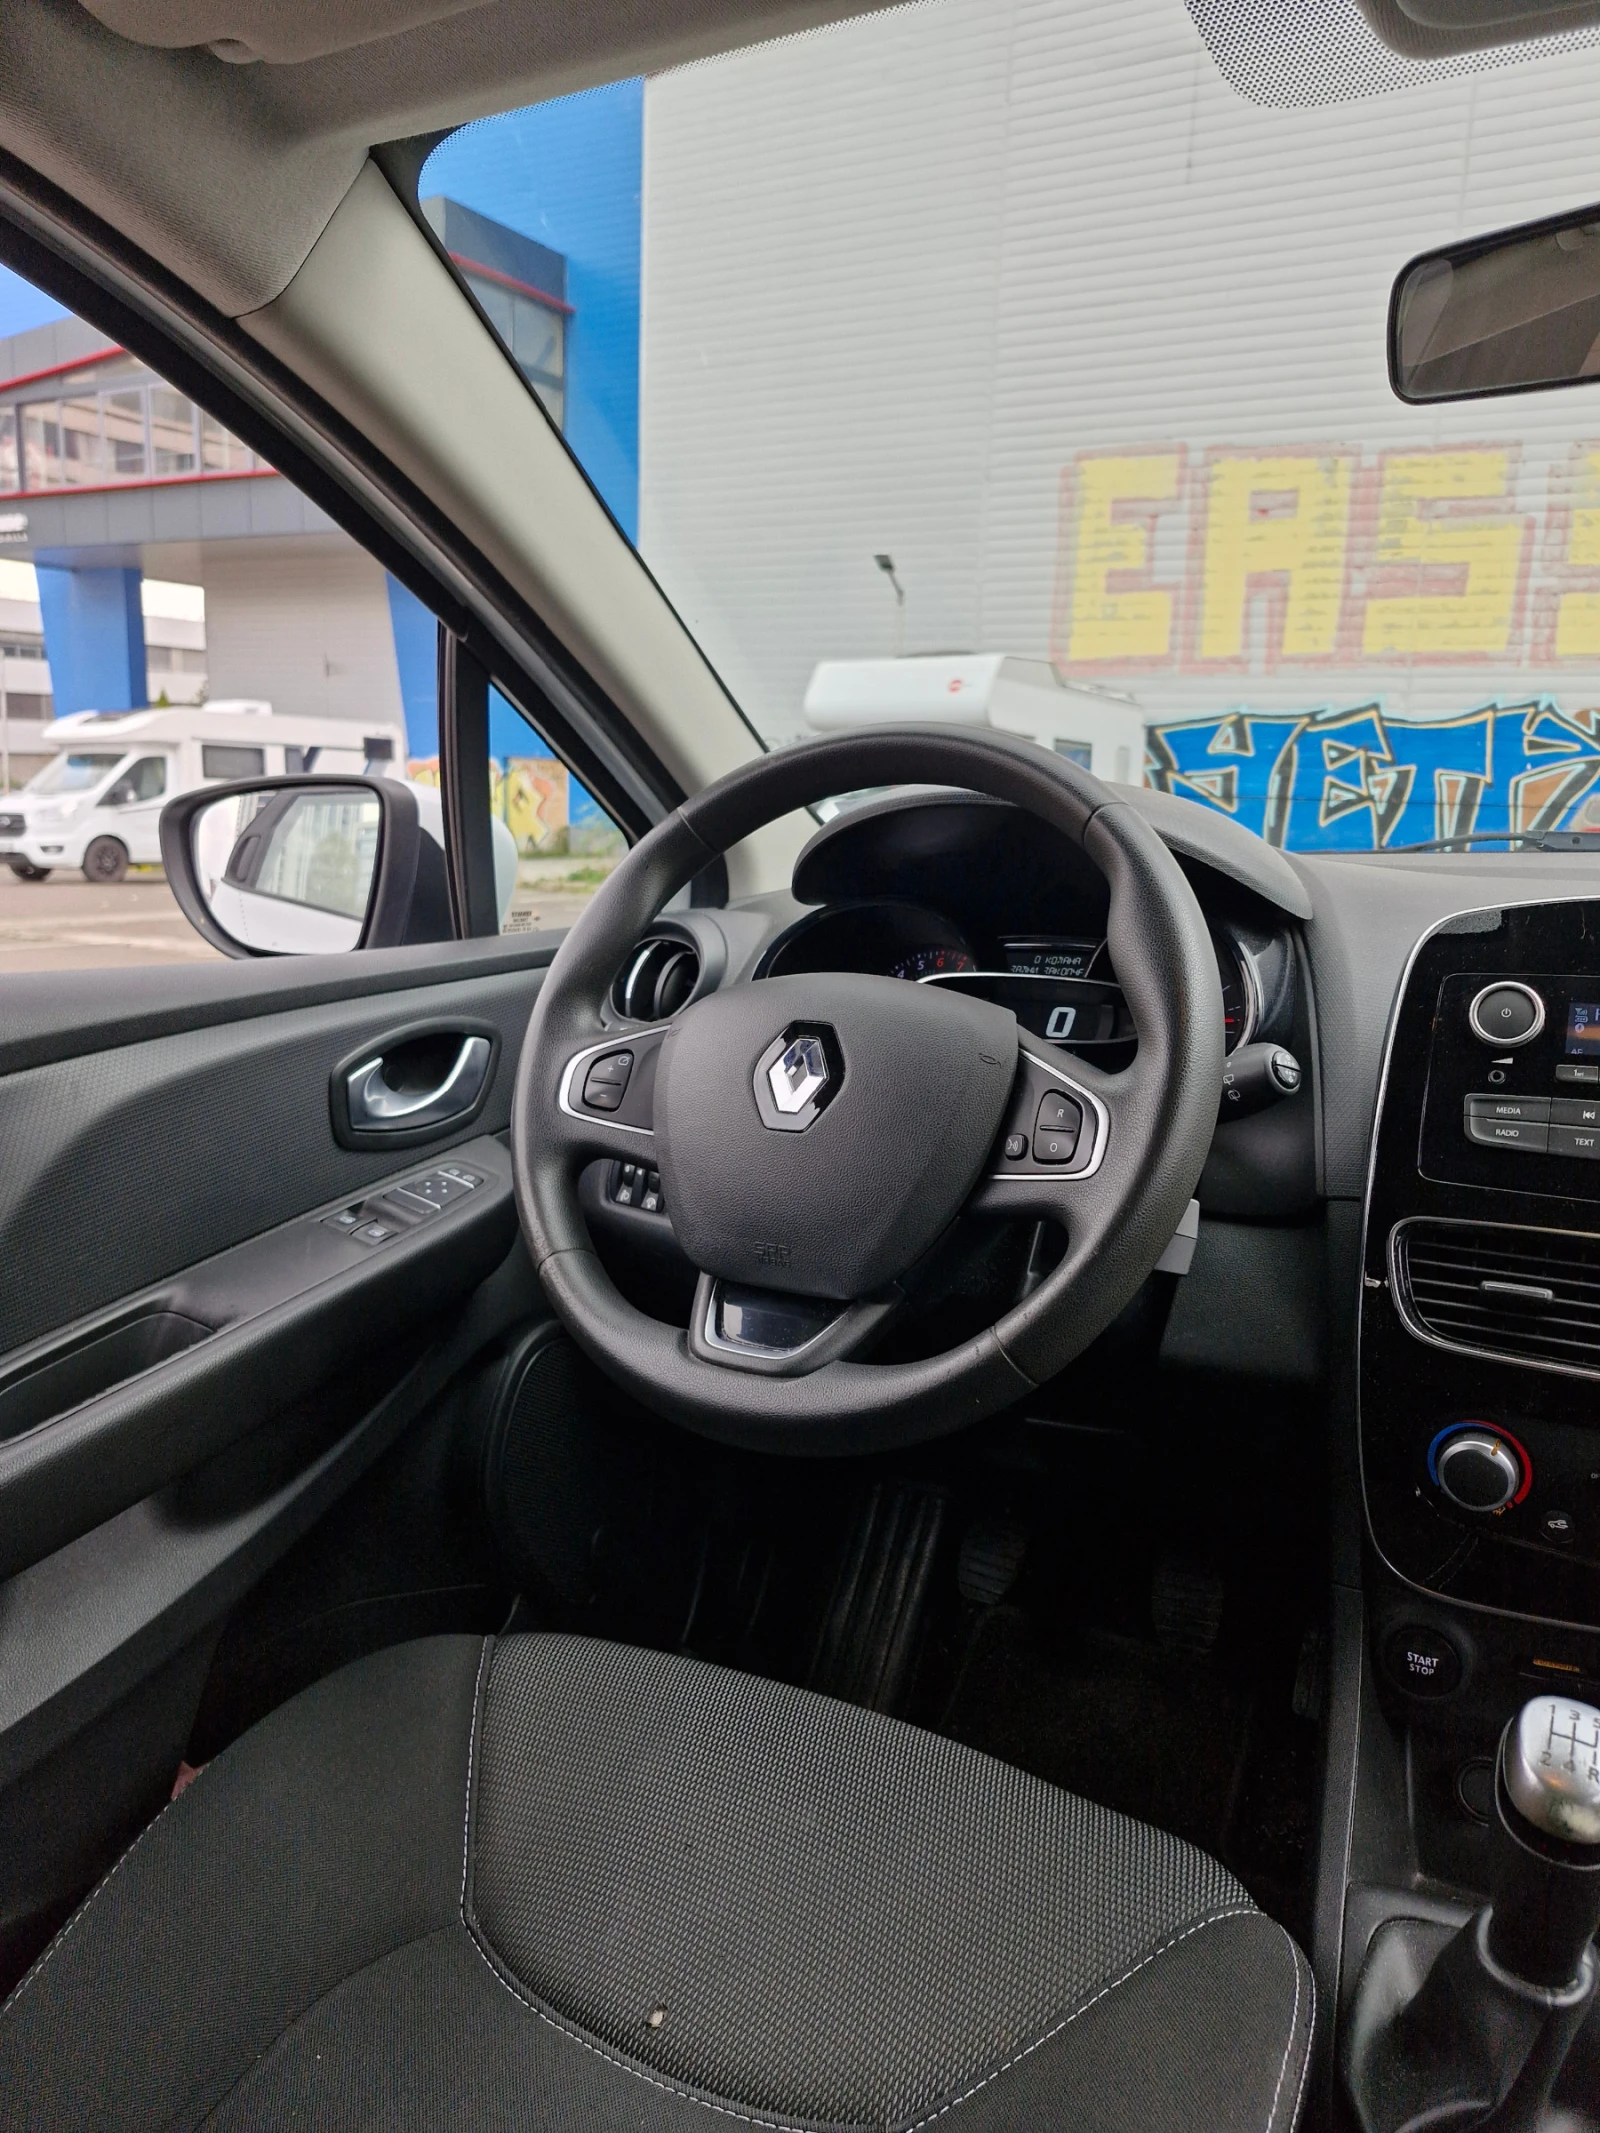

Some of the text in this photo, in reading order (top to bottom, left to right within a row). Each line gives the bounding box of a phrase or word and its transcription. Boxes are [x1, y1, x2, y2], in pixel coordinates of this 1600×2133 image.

[917, 960, 925, 970] 5
[936, 957, 945, 968] 6
[956, 960, 965, 972] 7
[1046, 1007, 1077, 1038] 0
[1056, 1108, 1065, 1118] R
[1495, 1106, 1521, 1116] MEDIA
[1495, 1128, 1520, 1138] RADIO
[1574, 1137, 1595, 1147] TEXT
[1406, 1651, 1440, 1668] START
[1409, 1663, 1435, 1676] STOP
[1549, 1704, 1556, 1714] 1
[1569, 1709, 1581, 1721] 3
[1538, 1750, 1552, 1766] 2
[1562, 1759, 1576, 1774] 4
[1588, 1767, 1600, 1784] R
